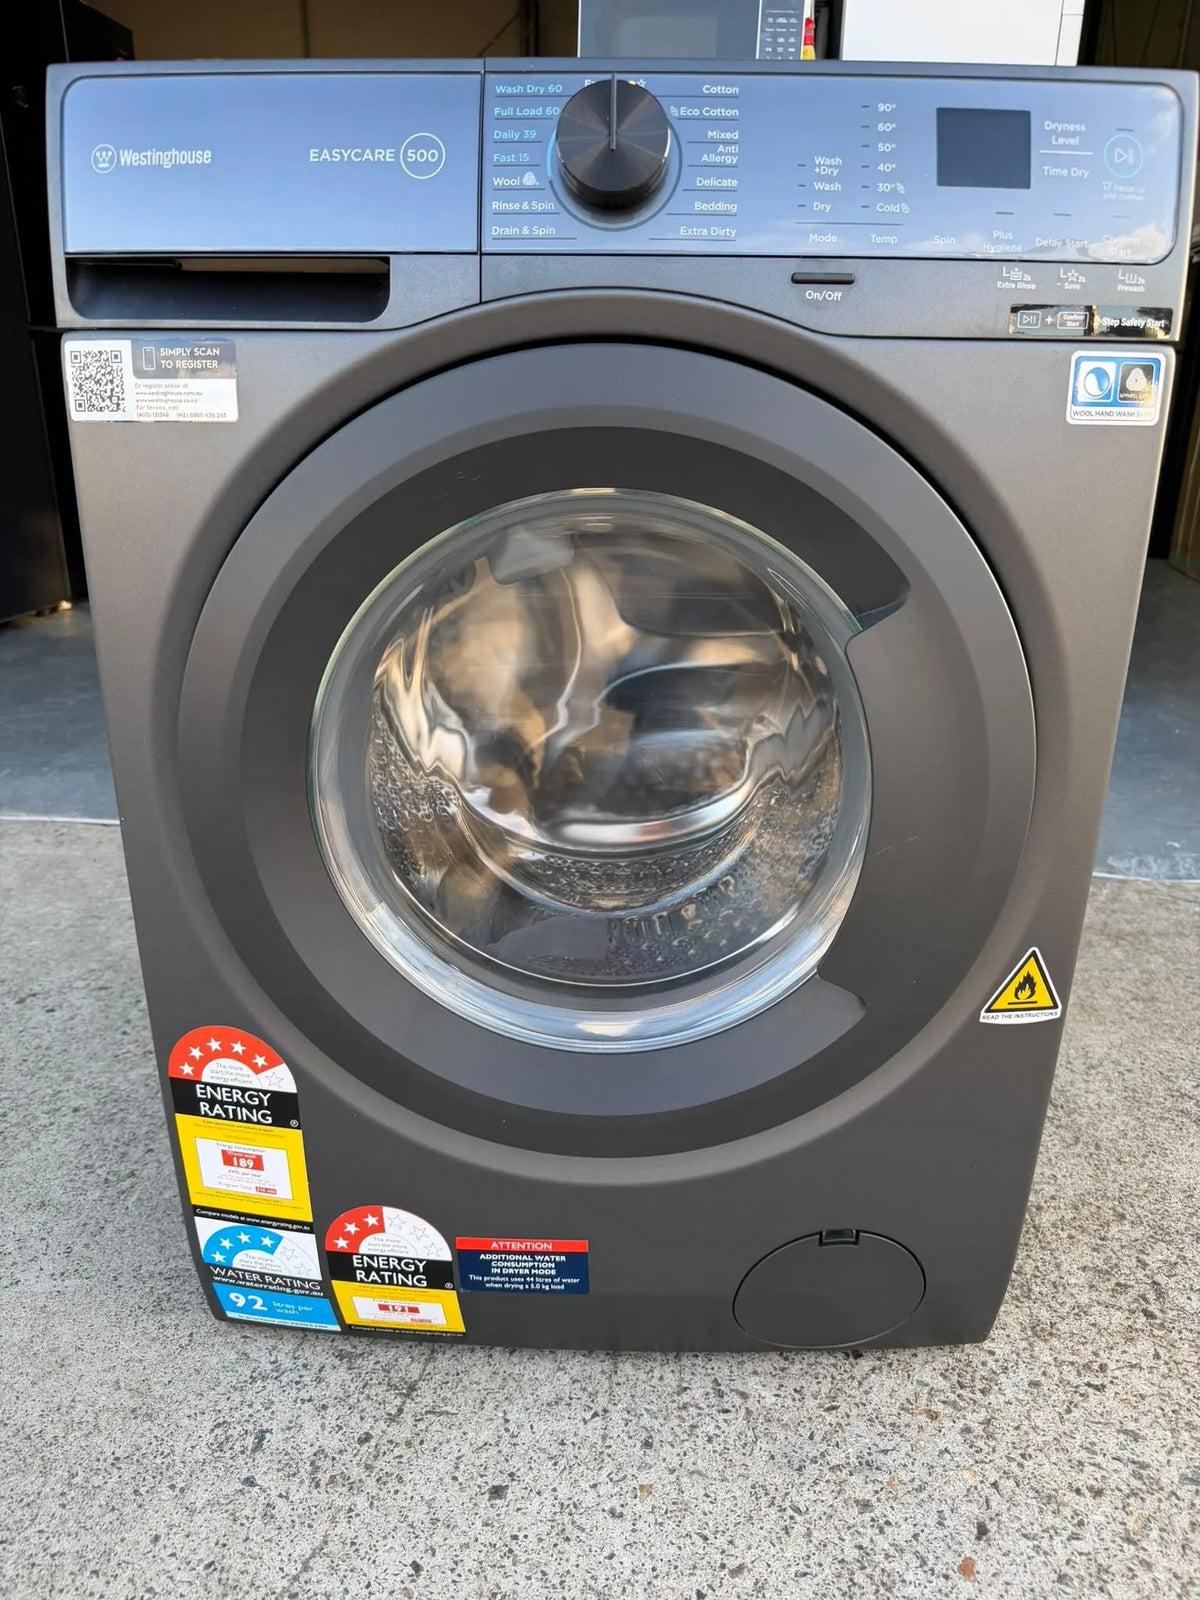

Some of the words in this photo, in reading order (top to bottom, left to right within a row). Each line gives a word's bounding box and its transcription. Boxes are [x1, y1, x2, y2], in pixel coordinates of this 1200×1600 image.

[495, 85, 524, 93] Wash
[526, 85, 546, 95] Dry
[548, 84, 563, 93] 60
[703, 85, 739, 94] Cotton
[494, 107, 514, 116] Full
[516, 107, 543, 116] Load
[546, 107, 560, 116] 60
[680, 108, 699, 117] Eco
[702, 108, 739, 117] Cotton
[1044, 121, 1086, 132] Dryness
[494, 129, 521, 141] Daily
[523, 130, 537, 139] 39
[708, 130, 739, 140] Mixed
[1052, 135, 1080, 146] Level
[717, 145, 739, 153] Anti
[119, 148, 212, 168] Westinghouse
[309, 148, 395, 163] EASYCARE
[406, 149, 439, 163] 500
[493, 153, 516, 163] Fast
[518, 154, 529, 162] 15
[701, 154, 738, 165] Allergy
[814, 156, 842, 165] Wash
[814, 166, 839, 176] +Dry
[1043, 167, 1068, 177] Time
[1071, 167, 1089, 179] Dry
[493, 177, 520, 186] Wool
[696, 177, 738, 187] Delicate
[813, 182, 841, 191] Wash
[492, 201, 520, 210] Rinse
[521, 202, 529, 210] &
[530, 201, 554, 212] Spin
[694, 202, 737, 213] Bedding
[813, 202, 832, 212] Dry
[876, 203, 900, 212] Cold
[492, 226, 519, 235] Drain
[521, 227, 529, 235] &
[531, 226, 555, 237] Spin
[680, 227, 708, 236] Extra
[710, 227, 736, 239] Dirty
[993, 230, 1013, 239] Plus
[809, 234, 838, 242] Mode
[871, 234, 898, 245] Temp
[934, 236, 956, 246] Spin
[1035, 238, 1063, 249] Delay
[1065, 239, 1088, 248] Start
[983, 242, 1022, 253] Hygiene
[997, 281, 1016, 289] Extra
[1017, 282, 1036, 290] Rinse
[1064, 282, 1080, 290] Save
[1117, 284, 1145, 292] Prewash
[805, 290, 842, 301] On/Off
[1121, 318, 1146, 328] Safety
[1147, 319, 1165, 328] Start
[160, 348, 192, 357] SIMPLY
[194, 348, 220, 356] SCAN
[160, 360, 174, 368] TO
[175, 360, 219, 368] REGISTER
[195, 1084, 271, 1107] ENERGY
[200, 1101, 273, 1123] RATING
[233, 1157, 254, 1168] 189
[491, 1241, 552, 1250] ATTENTION
[352, 1255, 427, 1273] ENERGY
[210, 1265, 262, 1282] WATER
[264, 1275, 321, 1290] RATING
[356, 1269, 428, 1287] RATING
[212, 1275, 324, 1297] www.waterrating.gov.au
[228, 1291, 268, 1311] 92
[272, 1301, 295, 1310] litres
[297, 1305, 314, 1313] per
